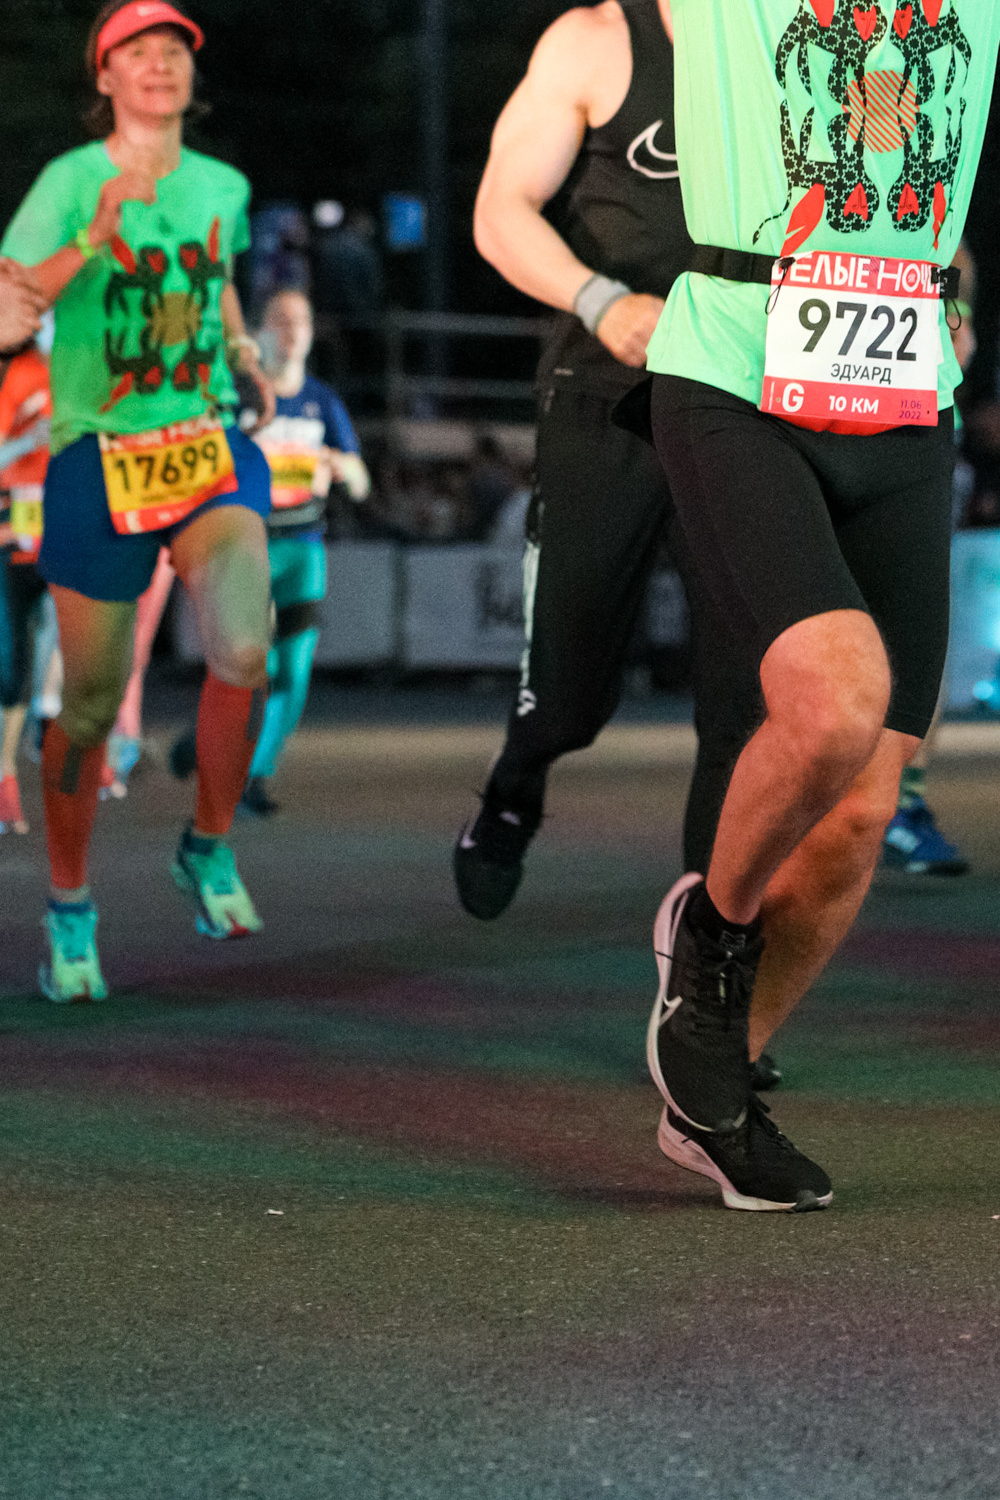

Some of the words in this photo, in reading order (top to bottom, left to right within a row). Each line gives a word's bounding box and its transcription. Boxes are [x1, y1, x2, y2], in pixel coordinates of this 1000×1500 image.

[798, 298, 918, 361] 9722
[830, 363, 892, 384] ЭДУАРД
[782, 383, 805, 413] G
[828, 395, 847, 412] 10
[851, 398, 879, 414] КМ
[899, 410, 921, 420] 2022
[114, 440, 218, 493] 17699
